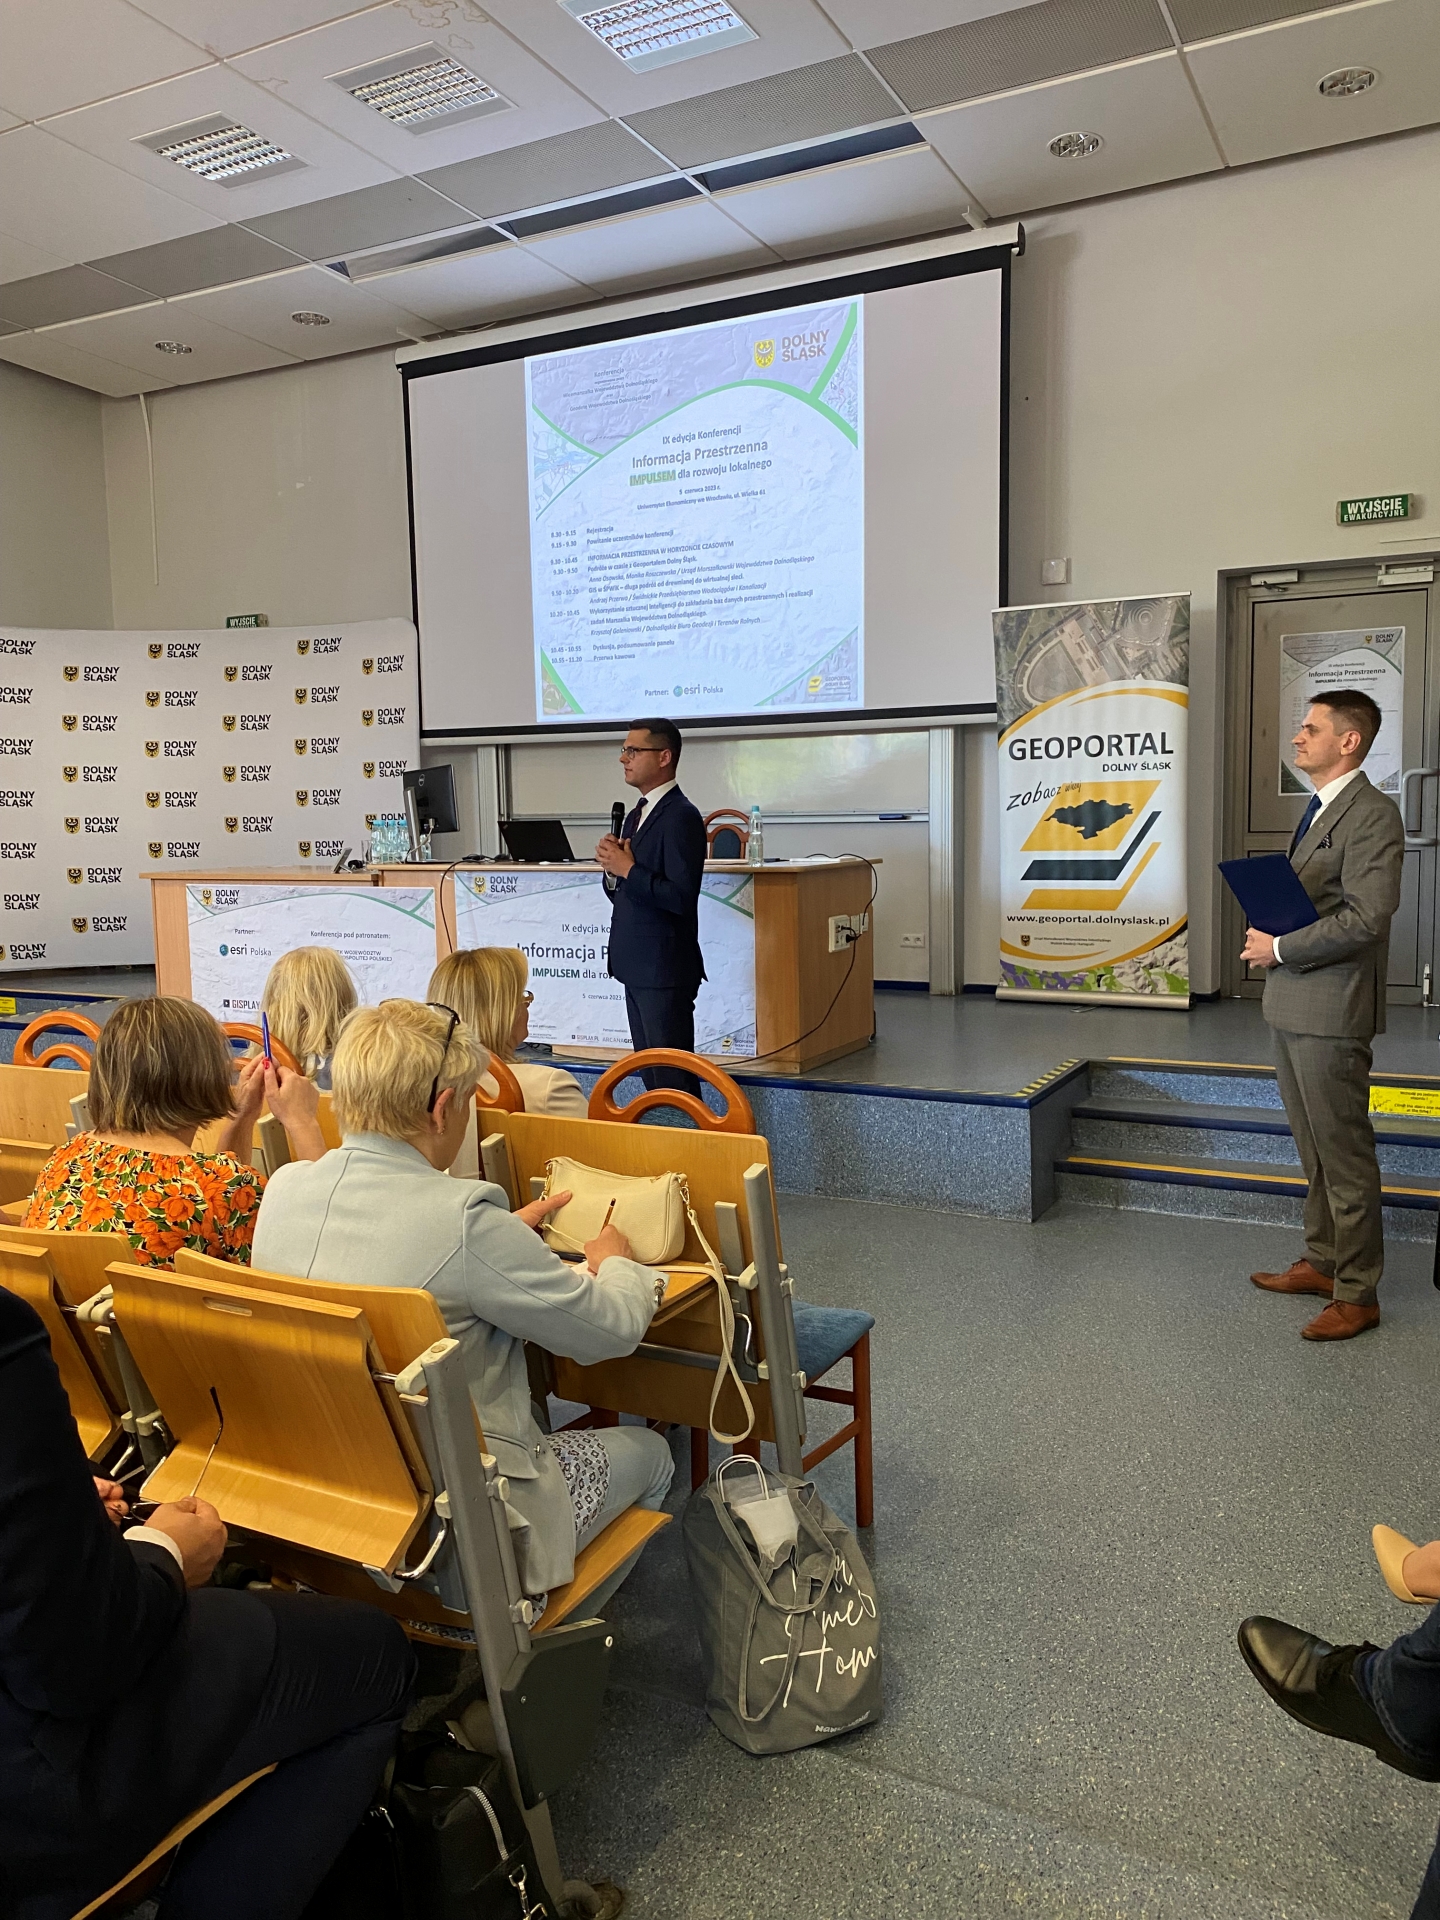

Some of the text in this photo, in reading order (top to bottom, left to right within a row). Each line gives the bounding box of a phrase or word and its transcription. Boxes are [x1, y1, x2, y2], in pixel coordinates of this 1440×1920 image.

[782, 329, 830, 350] DOLNY
[781, 343, 827, 363] ŚLĄSK
[594, 367, 625, 378] Konferencja
[662, 425, 742, 445] IX edycja Konferencji
[632, 441, 768, 469] Informacja Przestrzenna
[630, 459, 772, 487] IMPULSEM dla rozwoju lokalnego
[684, 487, 704, 495] czerwca
[704, 484, 717, 492] 2023
[637, 501, 665, 510] Uniwersytet
[666, 497, 696, 507] Ekonomiczny
[741, 490, 759, 498] Wielka
[1347, 497, 1402, 514] WYJŚCIE
[1343, 508, 1405, 522] EWAKUACYJNE
[586, 526, 614, 535] Rejestracja
[586, 537, 612, 545] Powitanie
[612, 534, 644, 542] uczestników
[644, 529, 674, 539] konferencji
[587, 552, 621, 561] INFORMACJA
[620, 549, 660, 558] PRZESTRZENNA
[667, 544, 700, 553] HORYZONCIE
[701, 540, 734, 550] CZASOWYM
[632, 559, 666, 568] Geoportalem
[666, 557, 682, 565] Dolny
[724, 596, 743, 604] danych
[229, 616, 256, 627] WYJŚCIE
[313, 637, 342, 646] DOLNY
[592, 643, 616, 651] Dyskusja,
[616, 641, 656, 650] podsumowanie
[656, 639, 675, 647] panelu
[167, 643, 201, 651] DOLNY
[313, 644, 340, 654] ŚLĄSK
[167, 650, 199, 659] ŚLĄSK
[377, 655, 404, 665] DOLNY
[84, 666, 120, 674] DOLNY
[242, 665, 273, 673] DOLNY
[377, 663, 403, 673] ŚLĄSK
[1308, 668, 1386, 678] Informacja Przestrzenna
[83, 673, 117, 682] ŚLĄSK
[241, 672, 271, 681] ŚLĄSK
[165, 691, 198, 699] DOLNY
[644, 684, 724, 697] Partner: esri Polska
[164, 698, 196, 707] ŚLĄSK
[377, 707, 406, 717] DOLNY
[82, 715, 118, 724] DOLNY
[377, 715, 405, 725] ŚLĄSK
[82, 722, 116, 732] ŚLĄSK
[164, 741, 197, 749] DOLNY
[311, 737, 340, 746] DOLNY
[1008, 731, 1174, 761] GEOPORTAL
[164, 748, 195, 757] ŚLĄSK
[311, 745, 339, 755] ŚLĄSK
[240, 765, 271, 774] DOLNY
[1102, 761, 1172, 773] DOLNY ŚLĄSK
[240, 773, 270, 783] ŚLĄSK
[312, 789, 341, 798] DOLNY
[1006, 781, 1062, 811] zobacz
[312, 797, 340, 807] ŚLĄSK
[84, 817, 120, 825] DOLNY
[84, 824, 118, 834] ŚLĄSK
[489, 876, 518, 886] DOLNY
[215, 889, 240, 898] DOLNY
[489, 884, 518, 894] ŚLĄSK
[4, 893, 41, 902] DOLNY
[215, 896, 239, 905] ŚLĄSK
[4, 901, 39, 911] ŚLĄSK
[92, 916, 128, 925] DOLNY
[1007, 914, 1170, 926] www.geoportal.dolnyslask.pl
[93, 924, 127, 933] ŚLĄSK
[561, 924, 570, 932] IX
[572, 924, 599, 935] edycja
[310, 930, 343, 939] Konferencja
[230, 943, 272, 956] esri Polska
[532, 967, 580, 979] IMPULSEM
[582, 969, 597, 979] dla
